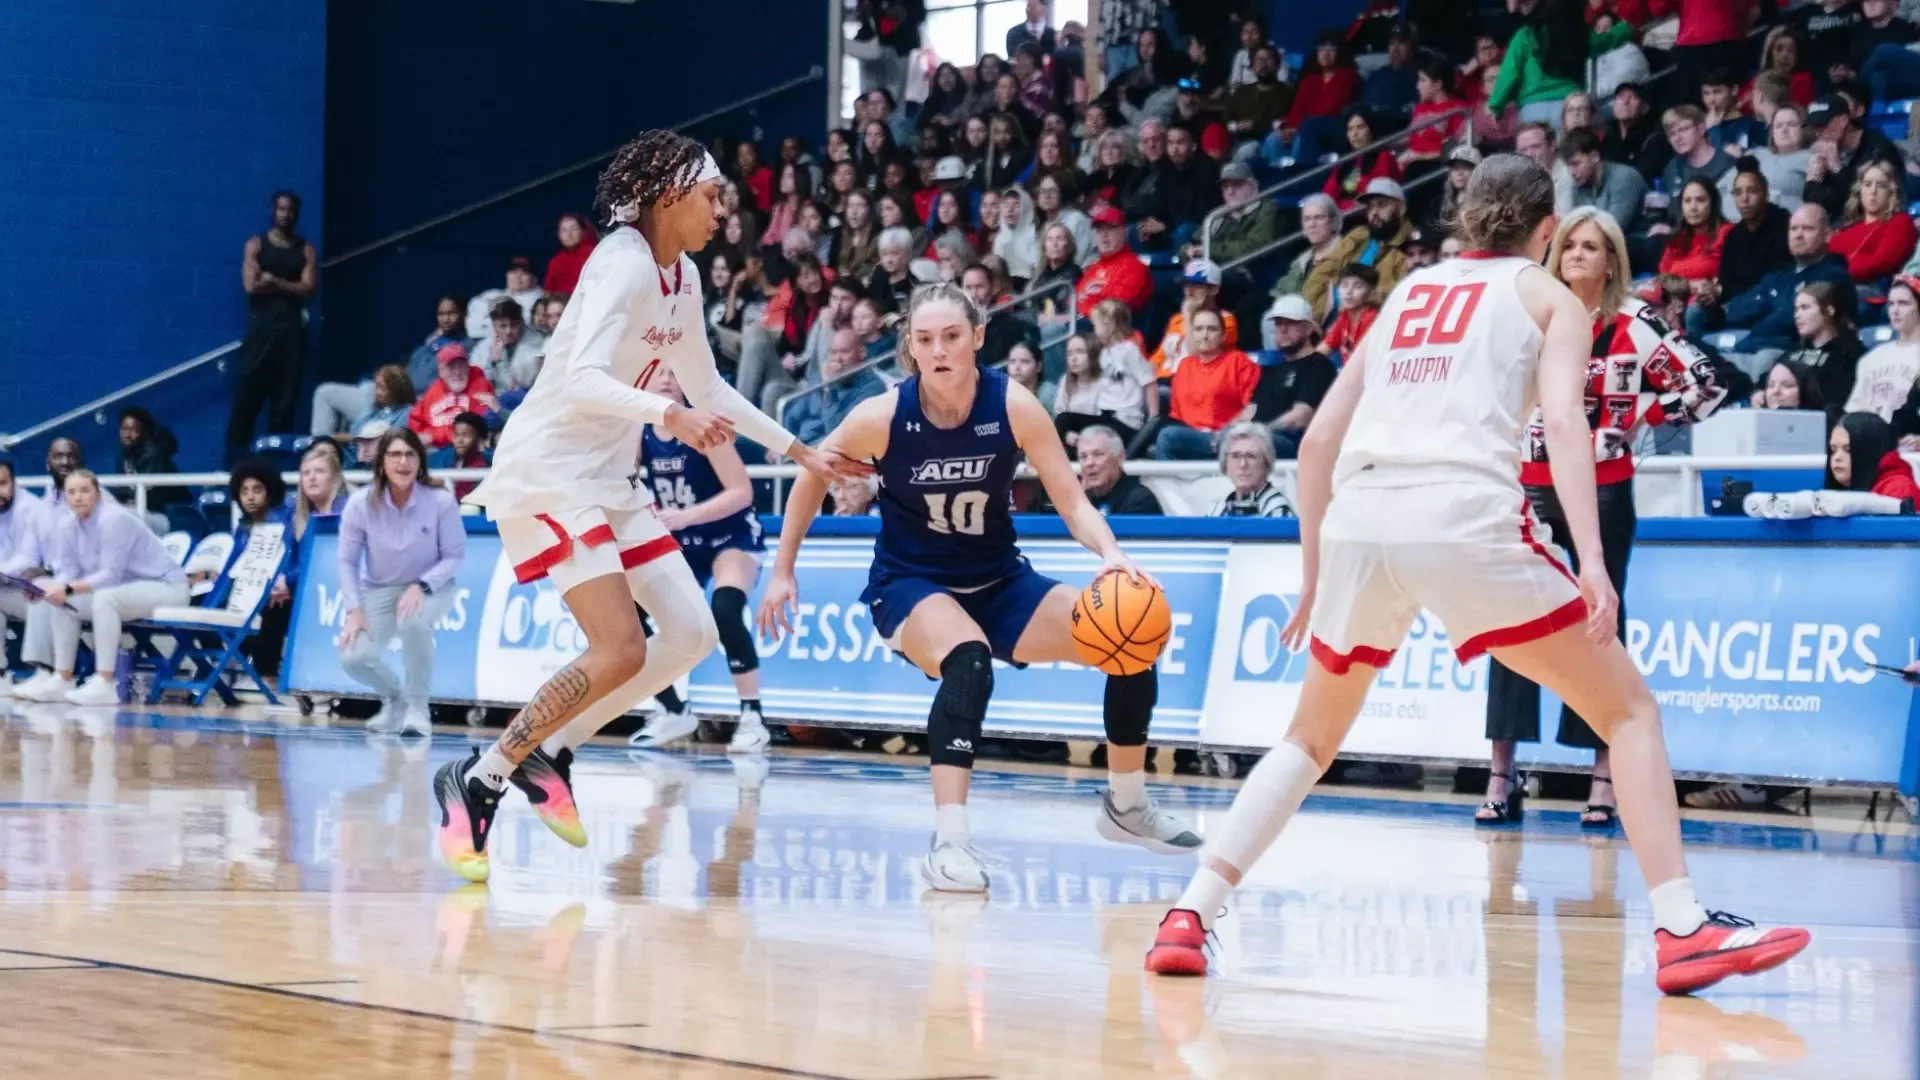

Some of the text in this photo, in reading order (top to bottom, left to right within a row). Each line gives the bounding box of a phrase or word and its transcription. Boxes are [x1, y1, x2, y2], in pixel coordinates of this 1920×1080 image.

[1390, 281, 1488, 350] 20
[1387, 355, 1454, 387] MAUPIN
[915, 458, 988, 482] ACU
[923, 490, 990, 535] 10
[1625, 619, 1880, 684] RANGLERS
[1652, 686, 1821, 714] wranglersports.com
